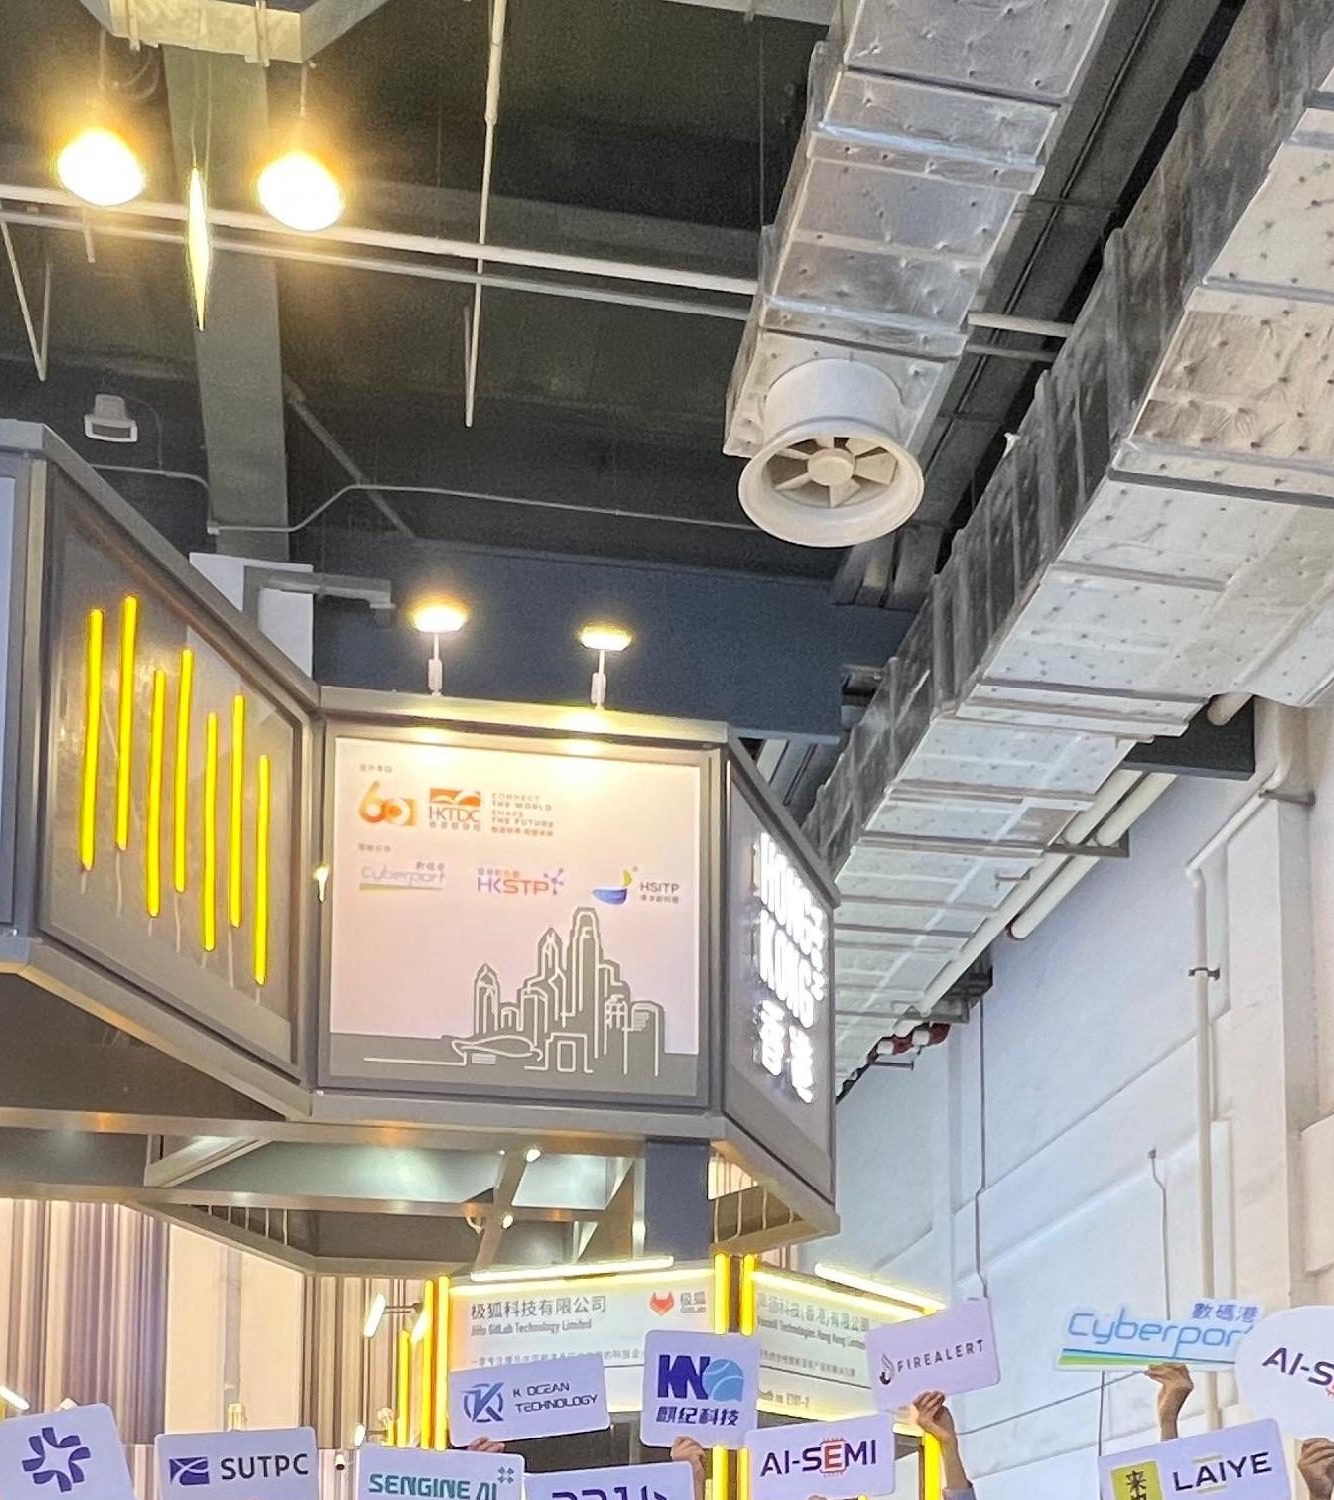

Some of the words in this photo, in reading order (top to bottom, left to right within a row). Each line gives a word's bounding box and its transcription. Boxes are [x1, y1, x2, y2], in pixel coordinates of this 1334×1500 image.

[429, 806, 481, 823] HKTDC
[361, 864, 446, 886] Cyberport
[477, 876, 549, 896] HKSTP
[640, 881, 680, 894] HSITP
[470, 1295, 607, 1321] 极狐科技有限公司
[1192, 1302, 1259, 1323] 數碼港
[515, 1322, 561, 1336] Technology
[562, 1319, 593, 1331] Limited
[1067, 1308, 1253, 1361] Cyberpor
[898, 1339, 984, 1373] FIREALERT
[527, 1382, 571, 1397] OCEAN
[515, 1394, 599, 1415] TECHNOLOGY
[220, 1452, 309, 1482] SUTPC
[760, 1438, 877, 1478] AI-SEMI
[1172, 1451, 1274, 1492] LAIYE
[368, 1472, 470, 1500] SENGINE
